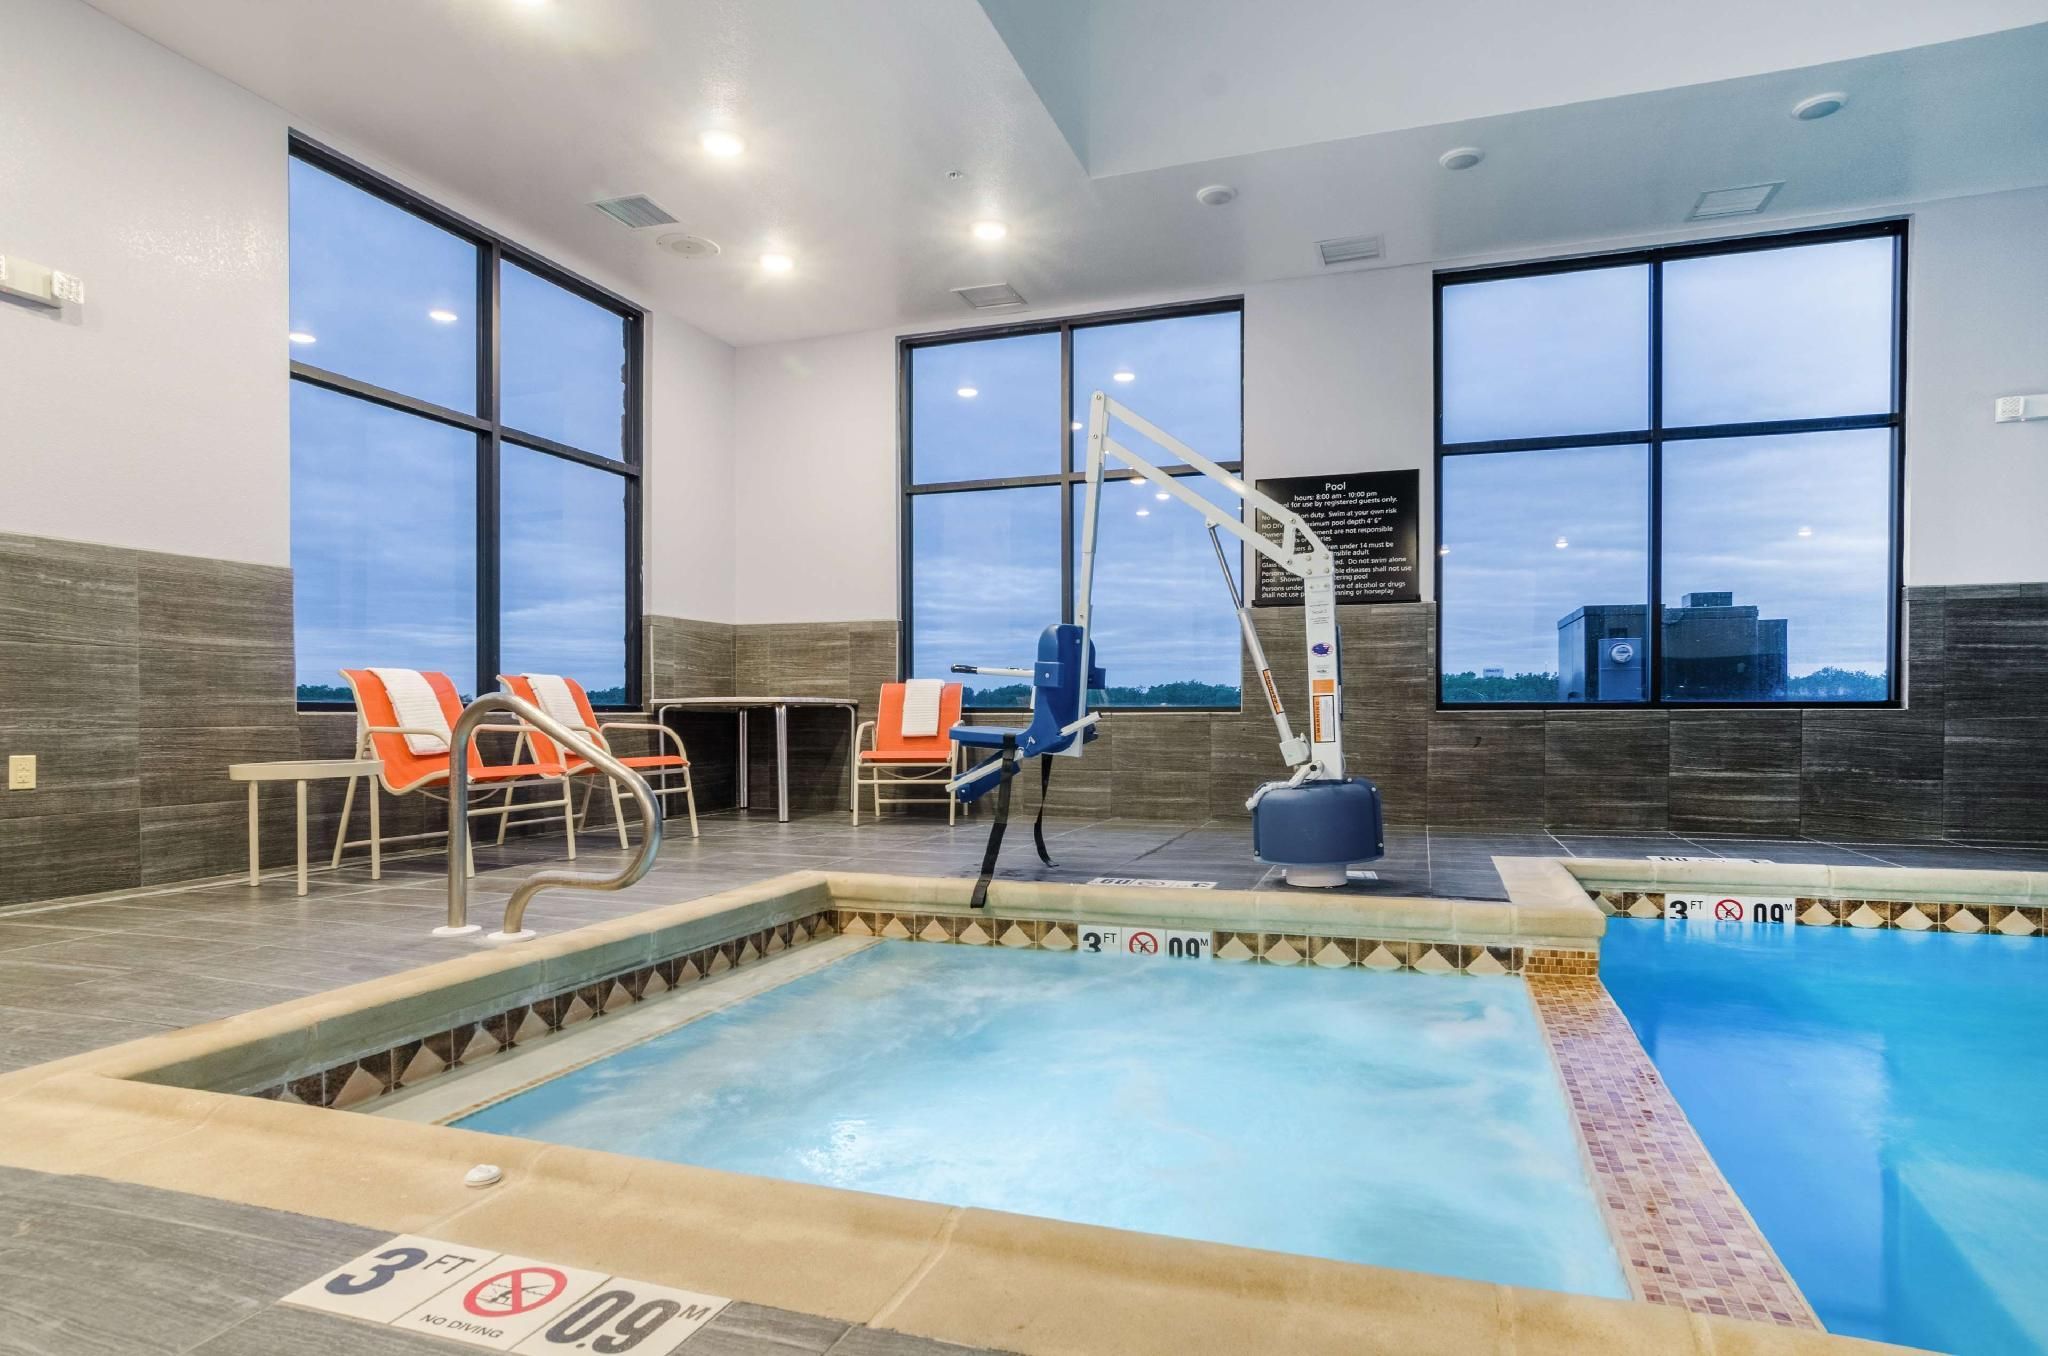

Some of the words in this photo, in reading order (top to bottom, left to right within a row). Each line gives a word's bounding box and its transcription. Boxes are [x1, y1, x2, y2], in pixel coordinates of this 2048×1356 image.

[1325, 481, 1346, 492] Pool
[1291, 501, 1301, 509] for
[1314, 500, 1323, 509] by
[1324, 498, 1358, 508] registered
[1359, 497, 1380, 505] guests
[1381, 495, 1398, 504] only.
[1294, 494, 1315, 502] hours:
[1331, 492, 1342, 500] am
[1348, 491, 1365, 499] 10:00
[1310, 511, 1326, 520] duty.
[1328, 510, 1346, 518] Swim
[1354, 509, 1369, 518] your
[1370, 508, 1385, 516] own
[1331, 519, 1346, 527] pool
[1346, 517, 1366, 526] depth
[1357, 526, 1394, 535] responsible
[1368, 540, 1385, 548] must
[1385, 540, 1394, 548] be
[1345, 565, 1371, 574] diseases
[1372, 565, 1387, 573] shall
[1400, 564, 1412, 572] use
[1353, 573, 1369, 581] pool
[1355, 581, 1378, 589] alcohol
[1387, 581, 1406, 589] drugs
[1363, 587, 1395, 597] horseplay
[1669, 900, 1688, 919] 3
[1690, 901, 1704, 910] FT
[1784, 903, 1793, 911] M
[1083, 932, 1102, 953] 3
[1103, 933, 1117, 944] FT
[1200, 938, 1209, 947] M
[324, 1247, 428, 1296] 3
[422, 1253, 477, 1275] FT
[545, 1289, 682, 1356] 0.9
[676, 1303, 712, 1322] M
[418, 1313, 449, 1329] NO
[446, 1319, 505, 1340] DIVING
